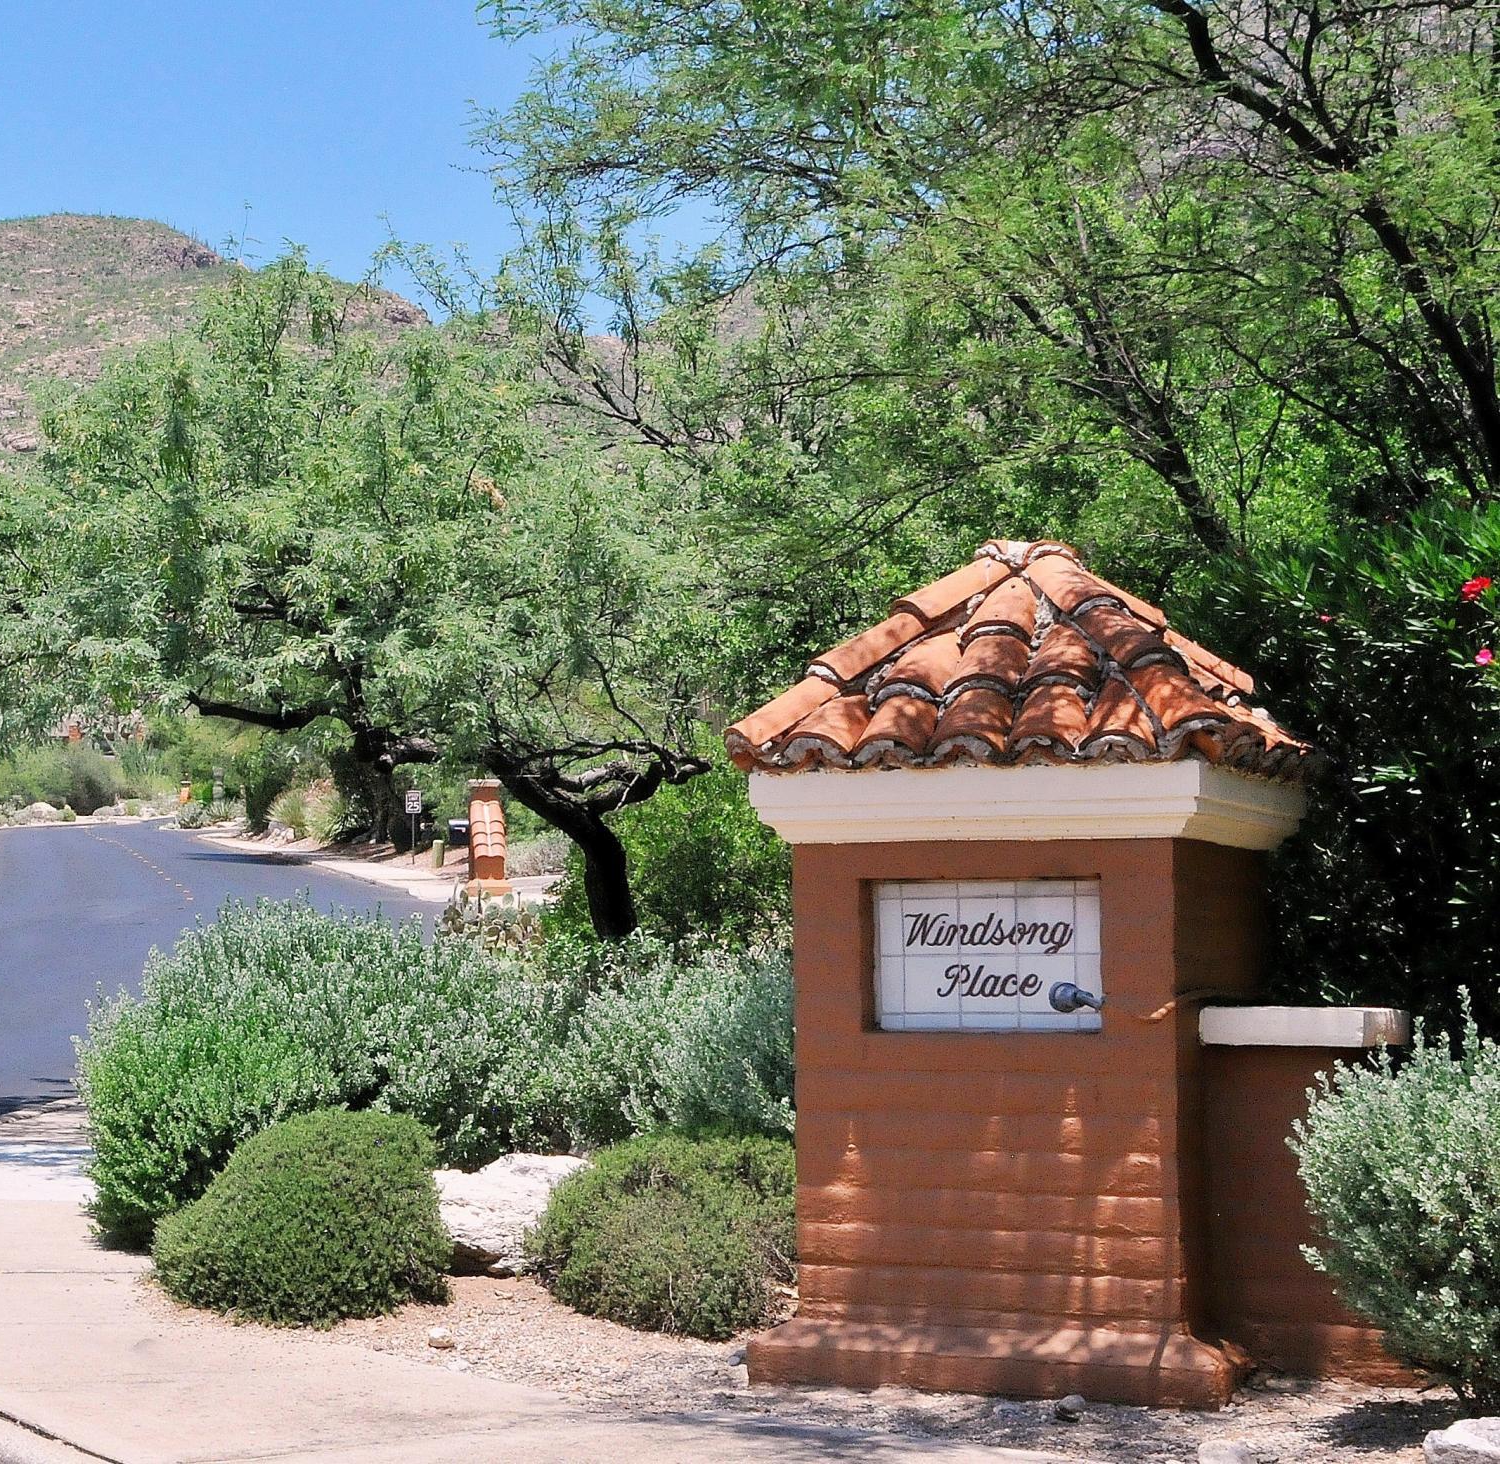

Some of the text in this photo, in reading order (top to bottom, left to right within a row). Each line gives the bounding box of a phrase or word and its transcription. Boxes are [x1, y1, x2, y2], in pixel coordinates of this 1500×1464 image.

[408, 801, 419, 811] 25
[904, 912, 1074, 955] Windsong
[936, 963, 1043, 998] Place
